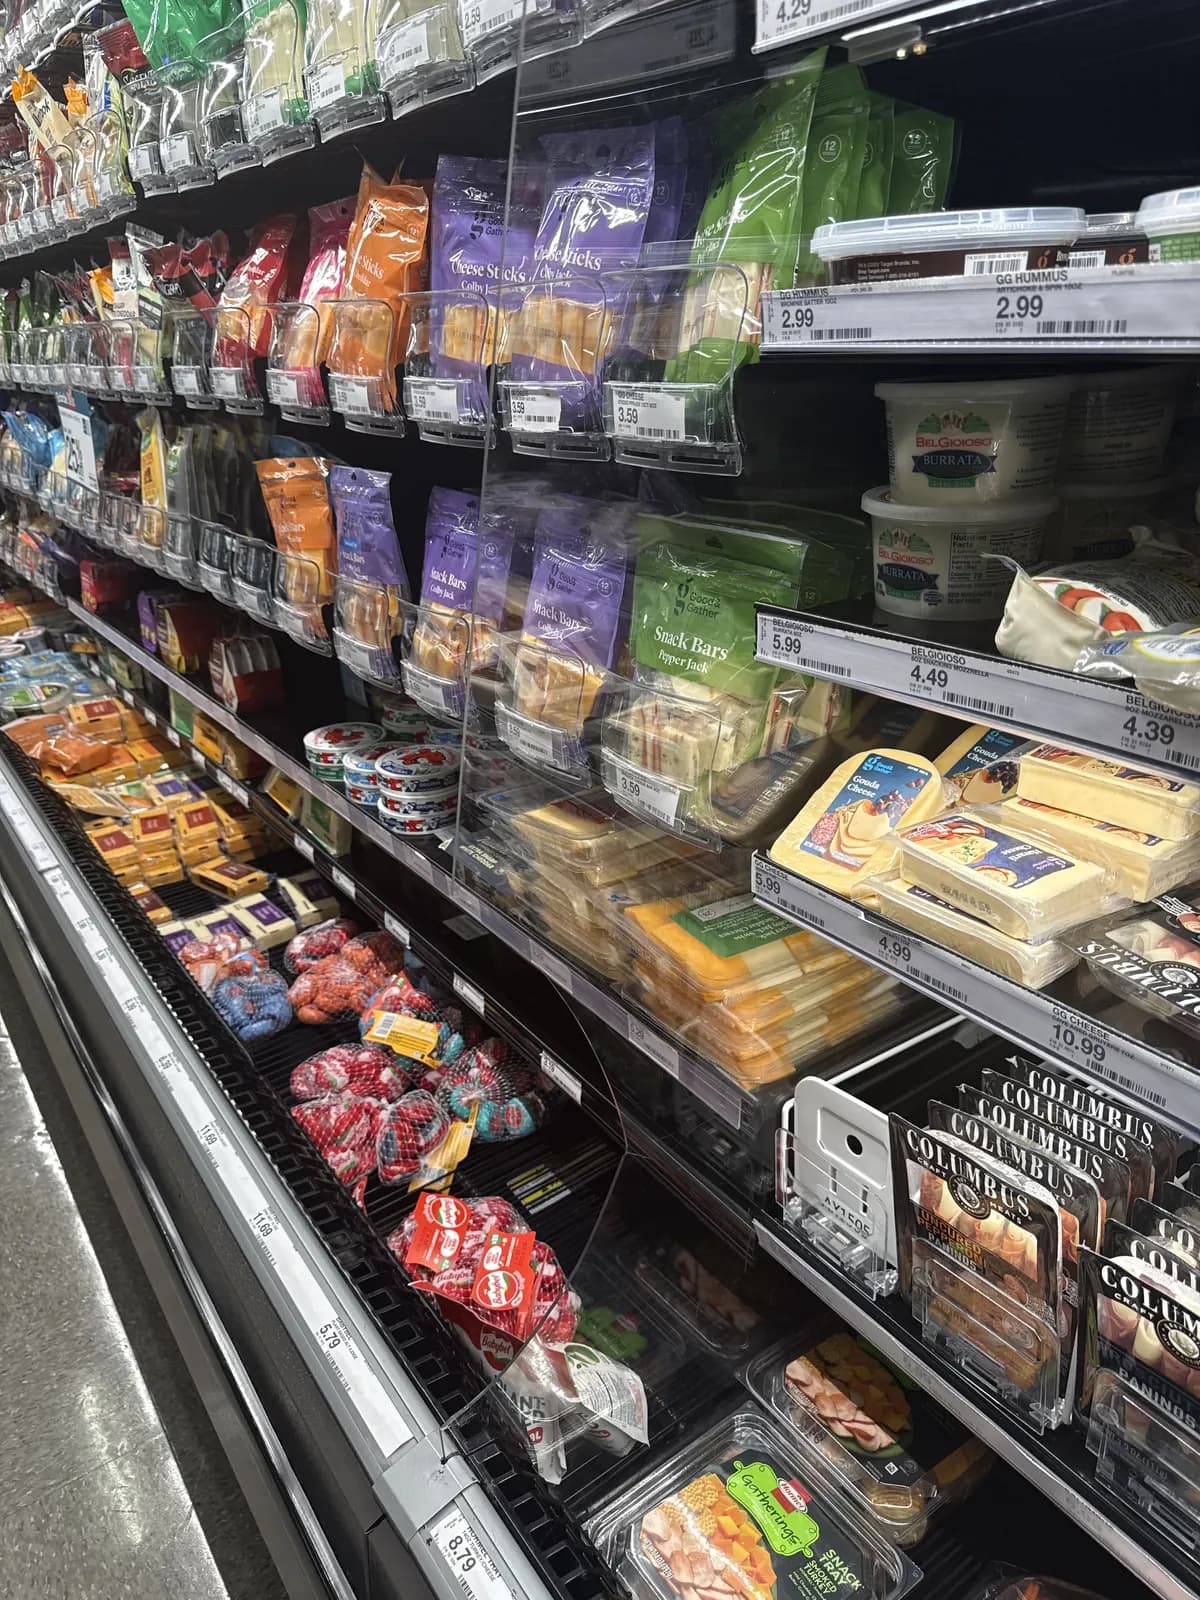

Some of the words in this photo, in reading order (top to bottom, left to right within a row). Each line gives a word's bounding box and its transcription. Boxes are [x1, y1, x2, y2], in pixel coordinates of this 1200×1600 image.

[766, 0, 811, 22] 4.29
[825, 141, 836, 151] 12
[996, 274, 1013, 285] GG
[1015, 270, 1068, 284] HUMMUS
[780, 290, 791, 300] GG
[792, 287, 829, 299] HUMMUS
[782, 308, 814, 328] 2.99
[996, 294, 1043, 320] 2.99
[512, 401, 525, 414] 3.59
[618, 406, 638, 424] 3.59
[923, 454, 982, 465] BURRATA
[447, 573, 467, 590] Bars
[532, 598, 559, 623] Snack
[686, 603, 719, 619] Gather
[690, 591, 721, 609] Good&
[772, 618, 815, 634] BELGIOIOSO
[654, 625, 688, 650] Snack
[691, 636, 729, 661] Bars
[772, 633, 801, 655] 5.99
[658, 649, 686, 667] Pepper
[685, 658, 710, 674] Jack
[911, 646, 966, 666] BELGIOIOSO
[910, 664, 948, 688] 4.49
[1123, 715, 1175, 745] 4.39
[973, 745, 999, 760] Gouda
[620, 777, 640, 796] 3.59
[847, 783, 877, 799] Cheese
[852, 775, 881, 790] Gouda
[755, 873, 781, 895] 5.99
[765, 862, 789, 881] CHEESE
[879, 935, 911, 962] 4.99
[1110, 944, 1148, 966] MEATS
[1052, 1006, 1068, 1020] GG
[1069, 1015, 1111, 1042] CHEESE
[1052, 1023, 1106, 1062] 10.99
[1002, 1081, 1127, 1159] COLUMBUS
[1028, 1069, 1153, 1147] COLUMBUS
[199, 1123, 218, 1146] 11.69
[978, 1098, 1103, 1181] COLUMBUS
[917, 1156, 947, 1178] CRAFT
[951, 1111, 1074, 1198] COLUMBUS
[906, 1128, 1030, 1218] COLUMBUS
[252, 1211, 274, 1237] 11.69
[990, 1201, 1022, 1224] MEATS
[920, 1209, 981, 1255] UNCURED
[491, 1273, 507, 1305] Babybel
[1113, 1292, 1155, 1319] CRAFT
[319, 1323, 341, 1350] 5.79
[1118, 1366, 1198, 1430] PANINOS
[780, 1481, 804, 1508] Hormel
[741, 1474, 800, 1546] Gatherings
[448, 1535, 476, 1572] 8.79
[803, 1563, 831, 1594] TURKEY
[809, 1560, 837, 1593] SMOKED
[819, 1553, 848, 1585] TRAY
[826, 1549, 863, 1591] SNACK
